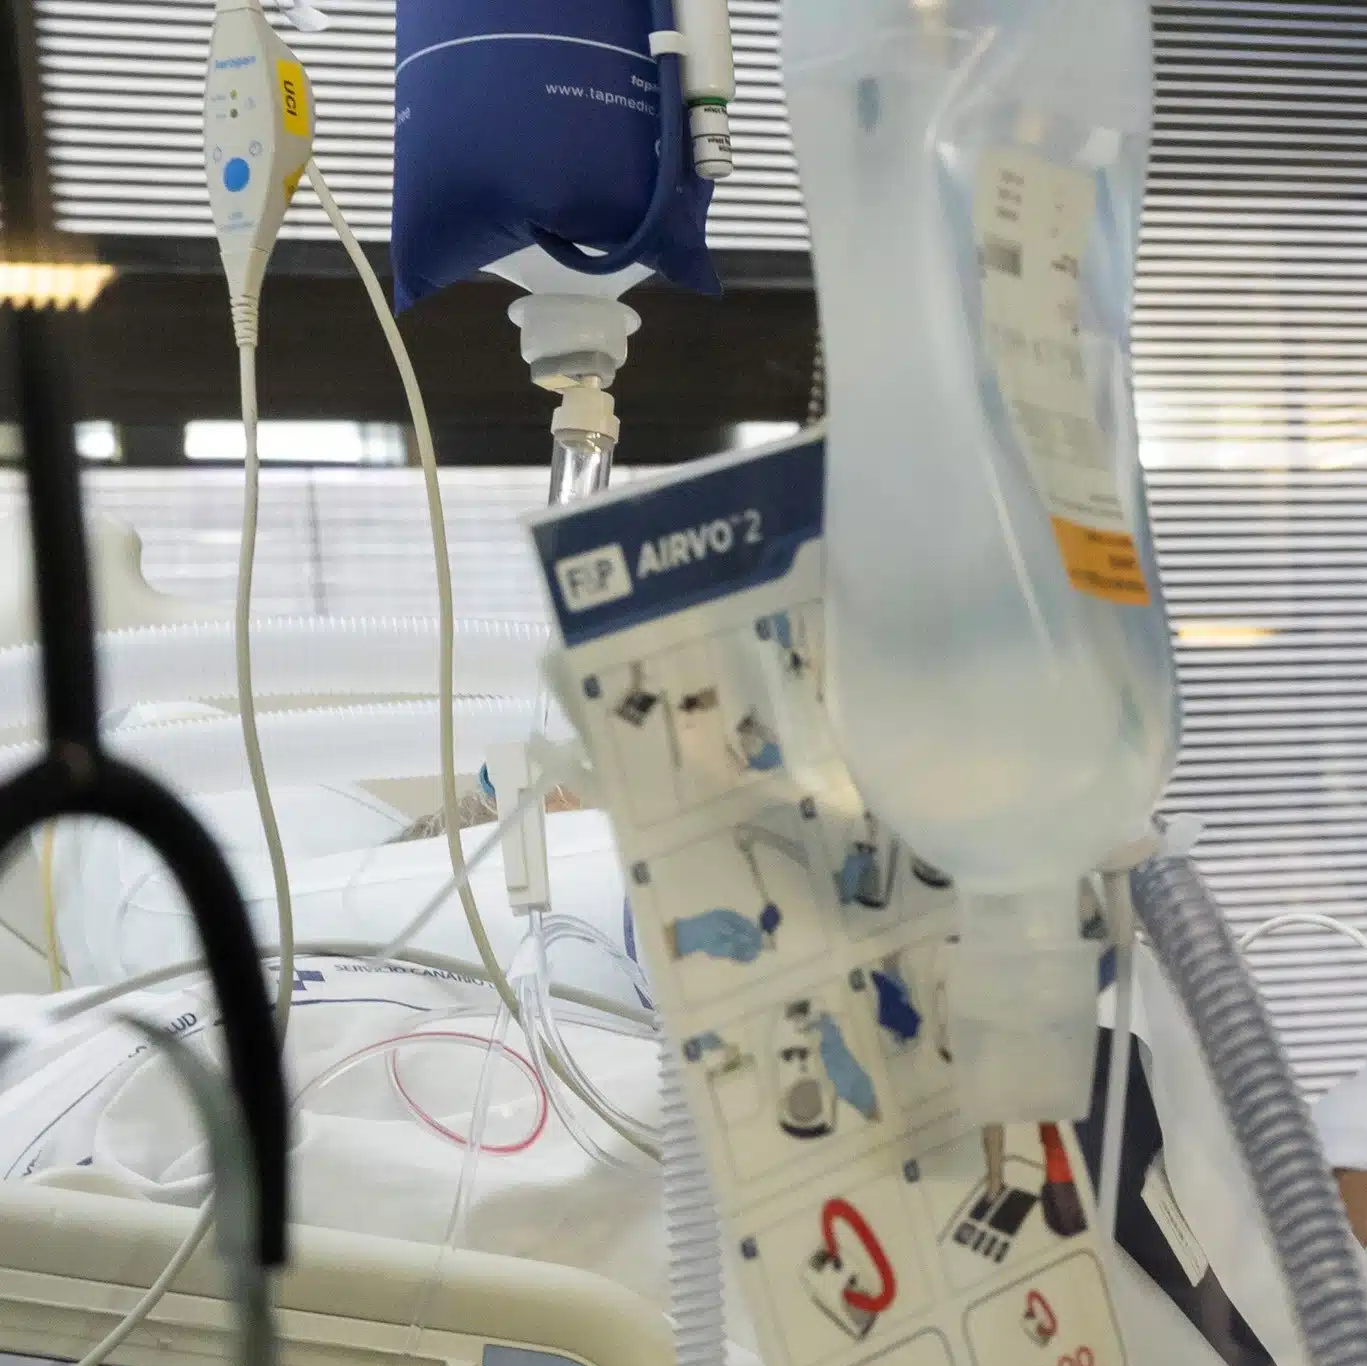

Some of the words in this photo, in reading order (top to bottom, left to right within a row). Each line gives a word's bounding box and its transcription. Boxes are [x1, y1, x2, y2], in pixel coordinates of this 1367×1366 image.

[283, 79, 297, 117] UCI
[545, 83, 661, 118] www.tapmedic
[743, 508, 765, 544] 2
